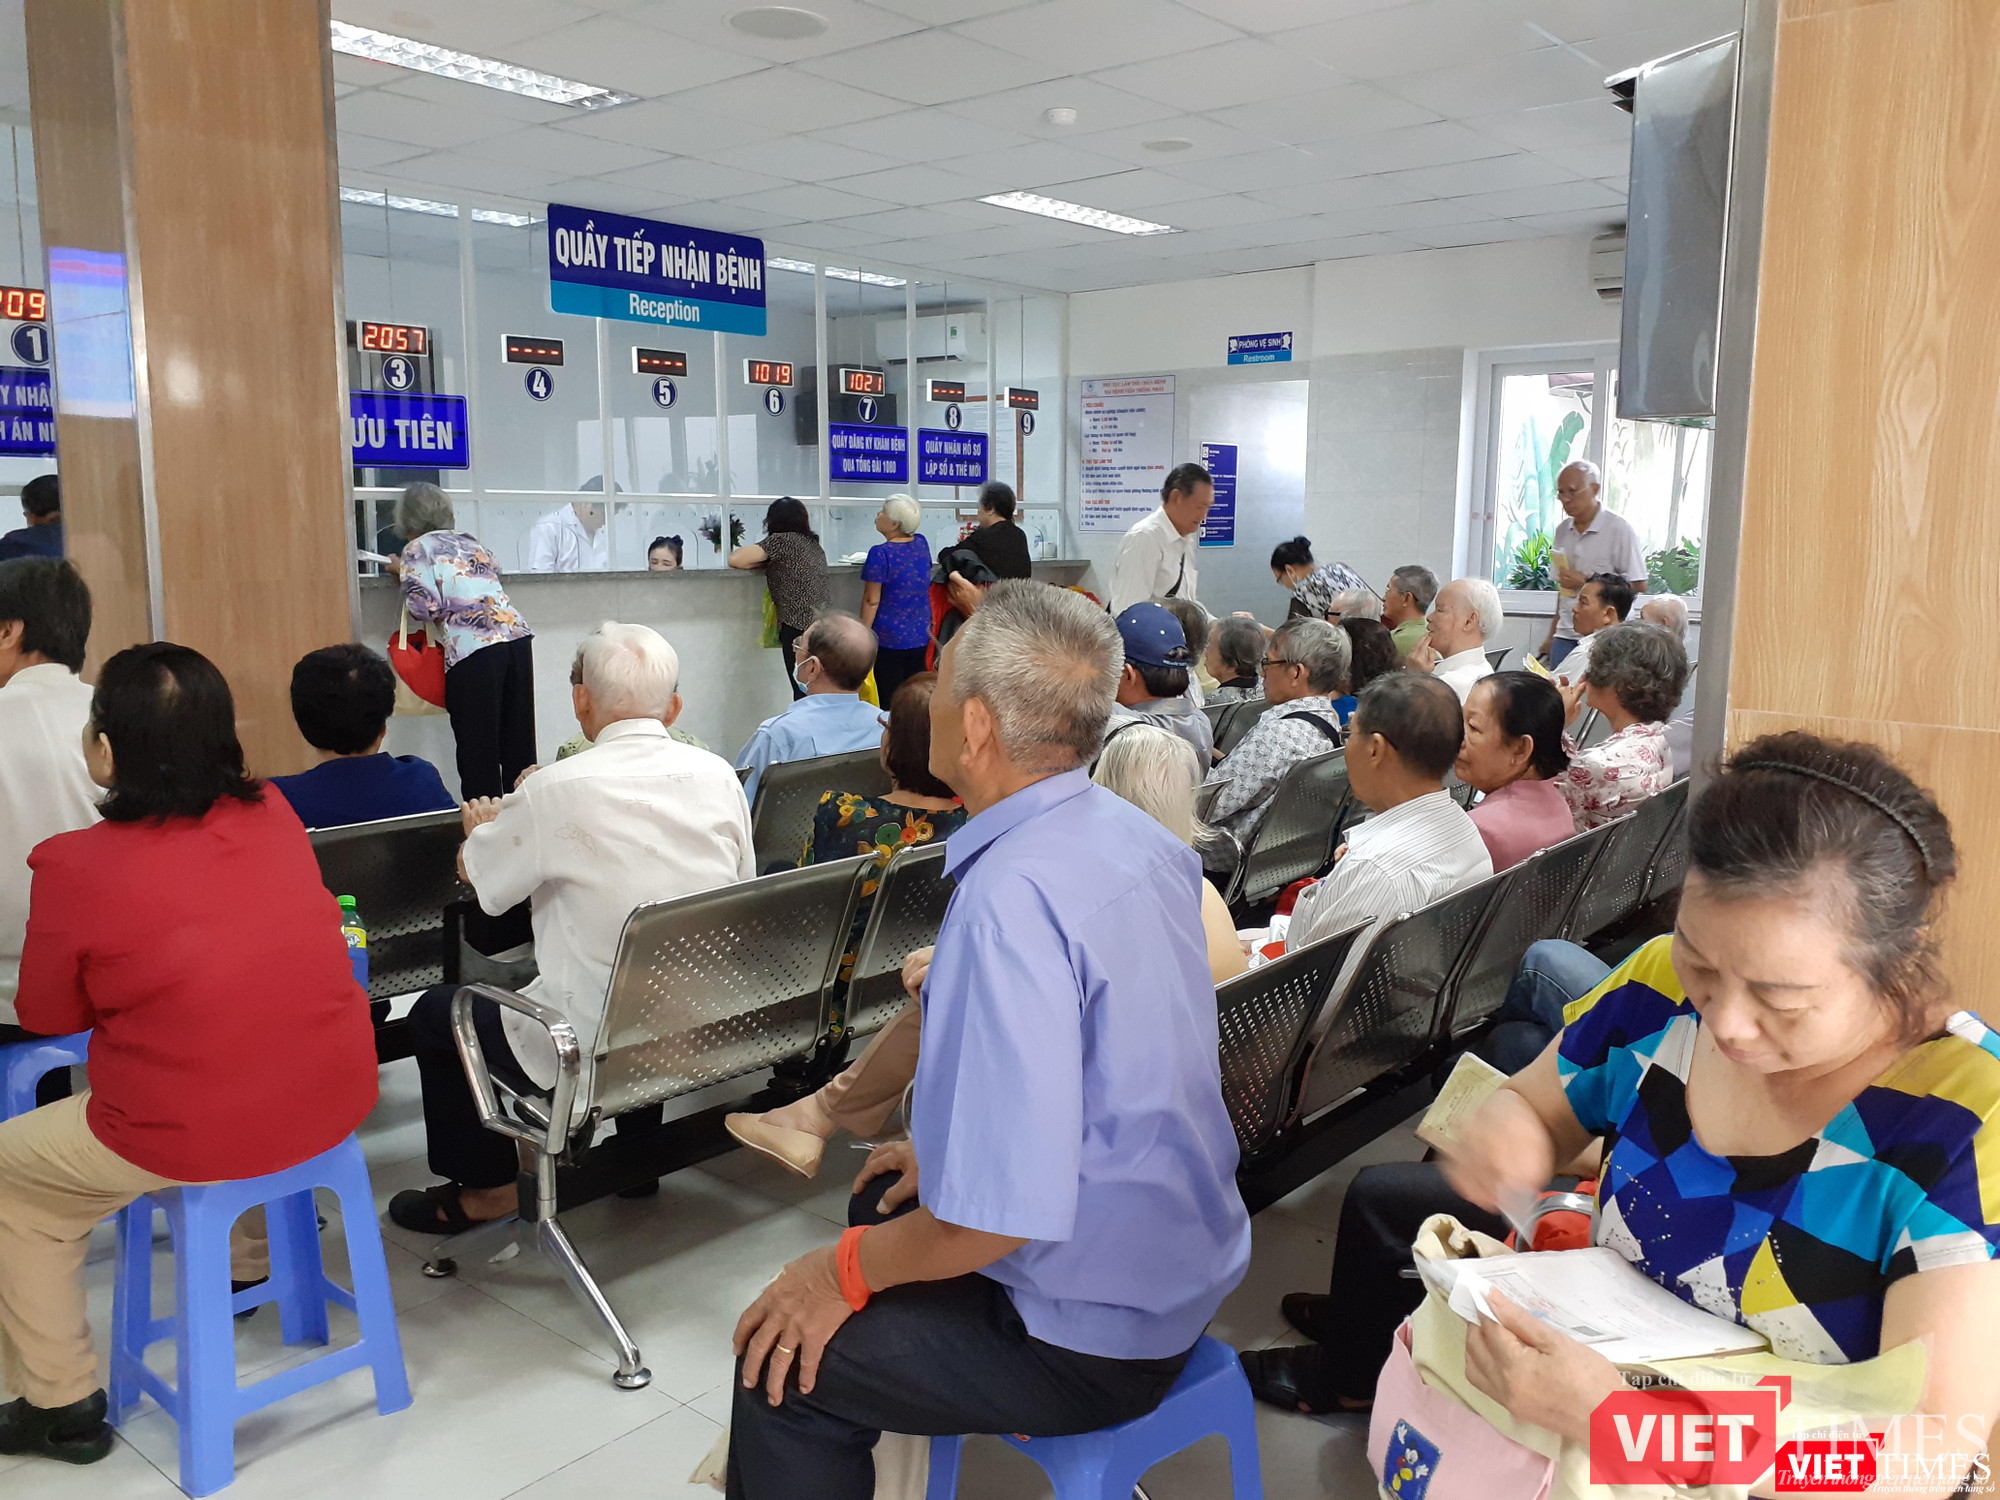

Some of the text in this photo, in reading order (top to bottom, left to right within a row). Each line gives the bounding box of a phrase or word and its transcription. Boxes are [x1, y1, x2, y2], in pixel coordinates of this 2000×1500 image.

[555, 219, 762, 295] QUẦY TIẾP NHẬN BỆNH
[0, 290, 46, 319] 09
[629, 293, 701, 323] Reception
[26, 328, 43, 361] 1
[364, 325, 424, 351] 2057
[1260, 338, 1267, 349] VỆ
[1268, 338, 1281, 347] SINH
[1243, 355, 1275, 363] Restroom
[390, 359, 407, 388] 3
[532, 371, 547, 397] 4
[754, 364, 791, 384] 1019
[849, 373, 882, 391] 1021
[15, 382, 51, 412] NHẬ
[658, 380, 671, 405] 5
[769, 389, 780, 413] 6
[862, 398, 872, 420] 7
[949, 406, 958, 428] 8
[12, 416, 33, 442] ÁN
[351, 413, 454, 450] ƯU TIÊN
[1023, 412, 1031, 433] 9
[873, 435, 890, 451] KHÁM
[891, 435, 906, 454] BỆNH
[944, 439, 961, 457] NHẬN
[973, 442, 982, 456] SƠ
[843, 458, 855, 473] QUA
[925, 458, 981, 478] LẬP SỔ & THẺ MỚI
